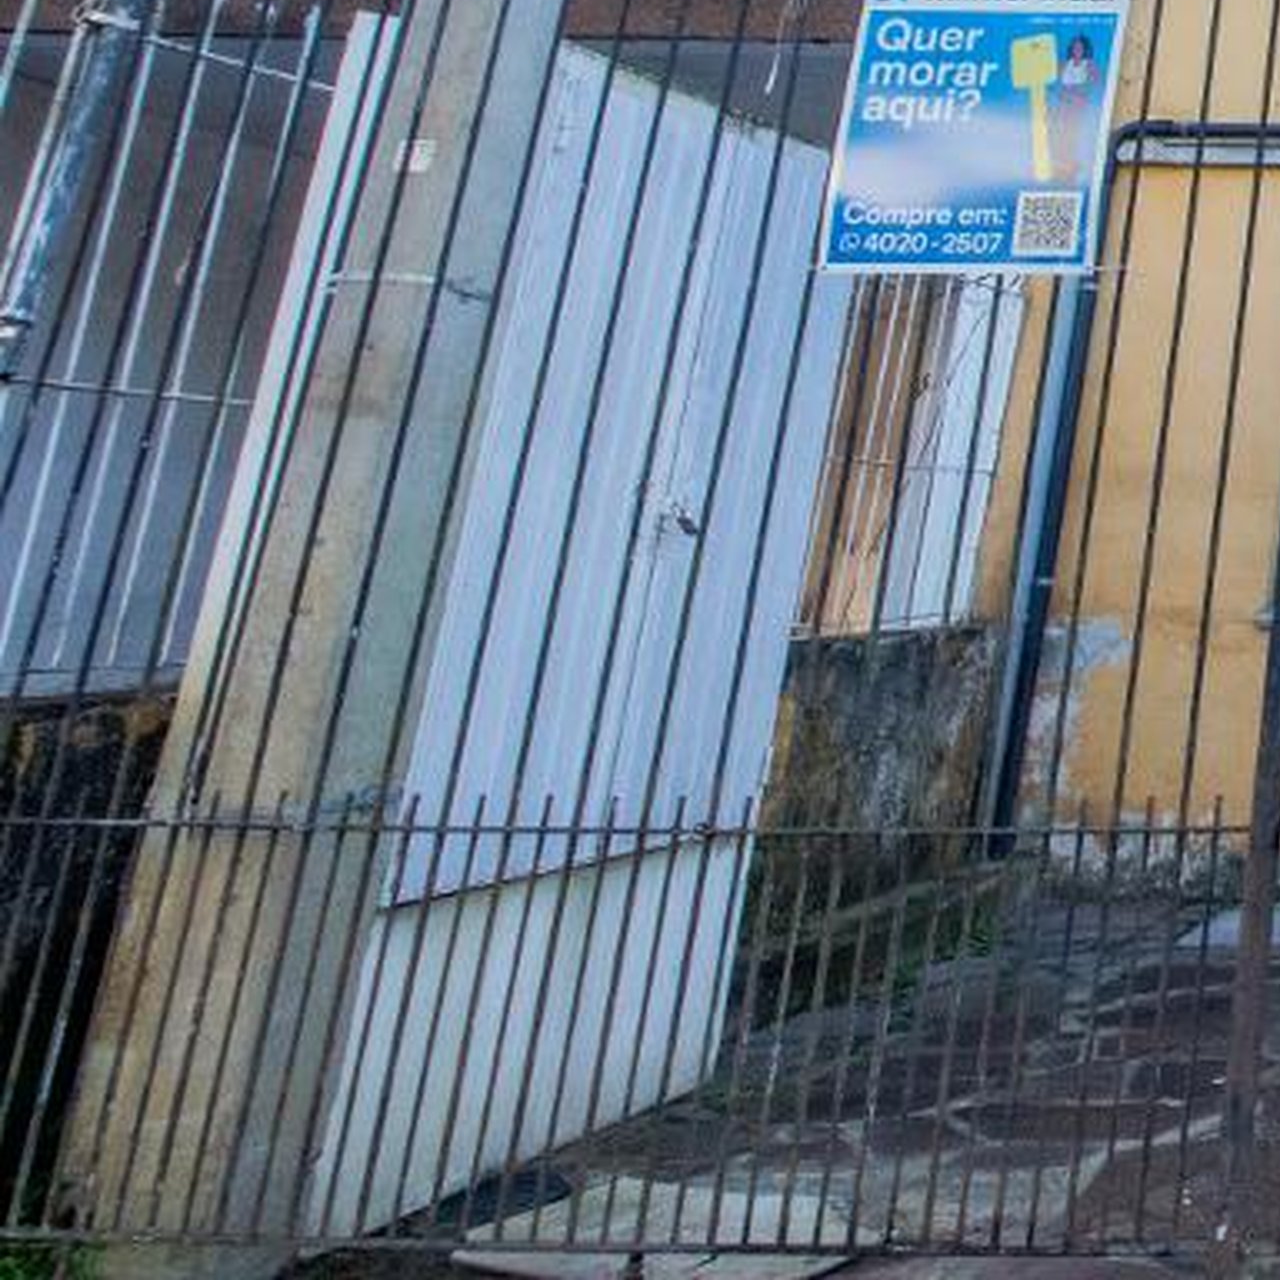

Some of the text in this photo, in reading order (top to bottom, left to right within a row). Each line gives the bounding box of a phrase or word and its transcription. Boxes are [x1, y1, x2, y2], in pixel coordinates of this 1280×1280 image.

[876, 19, 984, 50] Quer
[868, 58, 998, 87] morar
[861, 89, 981, 127] aqui?
[843, 201, 1008, 229] Compre em:
